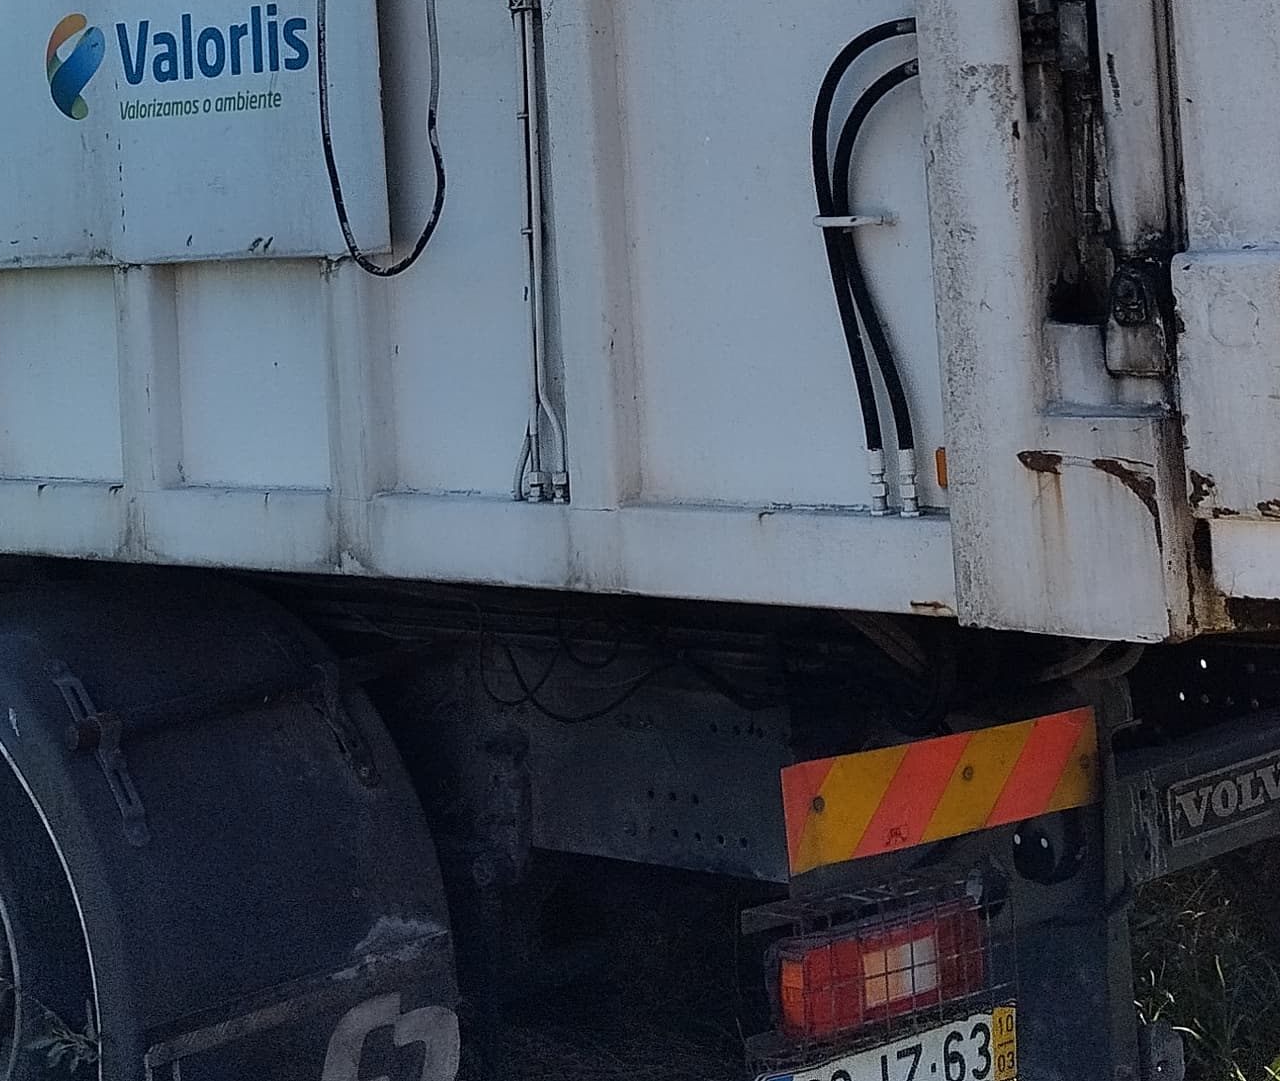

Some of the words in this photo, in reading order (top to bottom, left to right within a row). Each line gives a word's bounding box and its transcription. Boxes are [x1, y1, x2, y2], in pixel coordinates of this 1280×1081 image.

[115, 3, 310, 85] Valorlis
[119, 97, 199, 120] Valorizamos
[202, 98, 211, 113] o
[215, 90, 282, 112] ambiente
[997, 1014, 1015, 1035] 10
[996, 1051, 1015, 1075] 03
